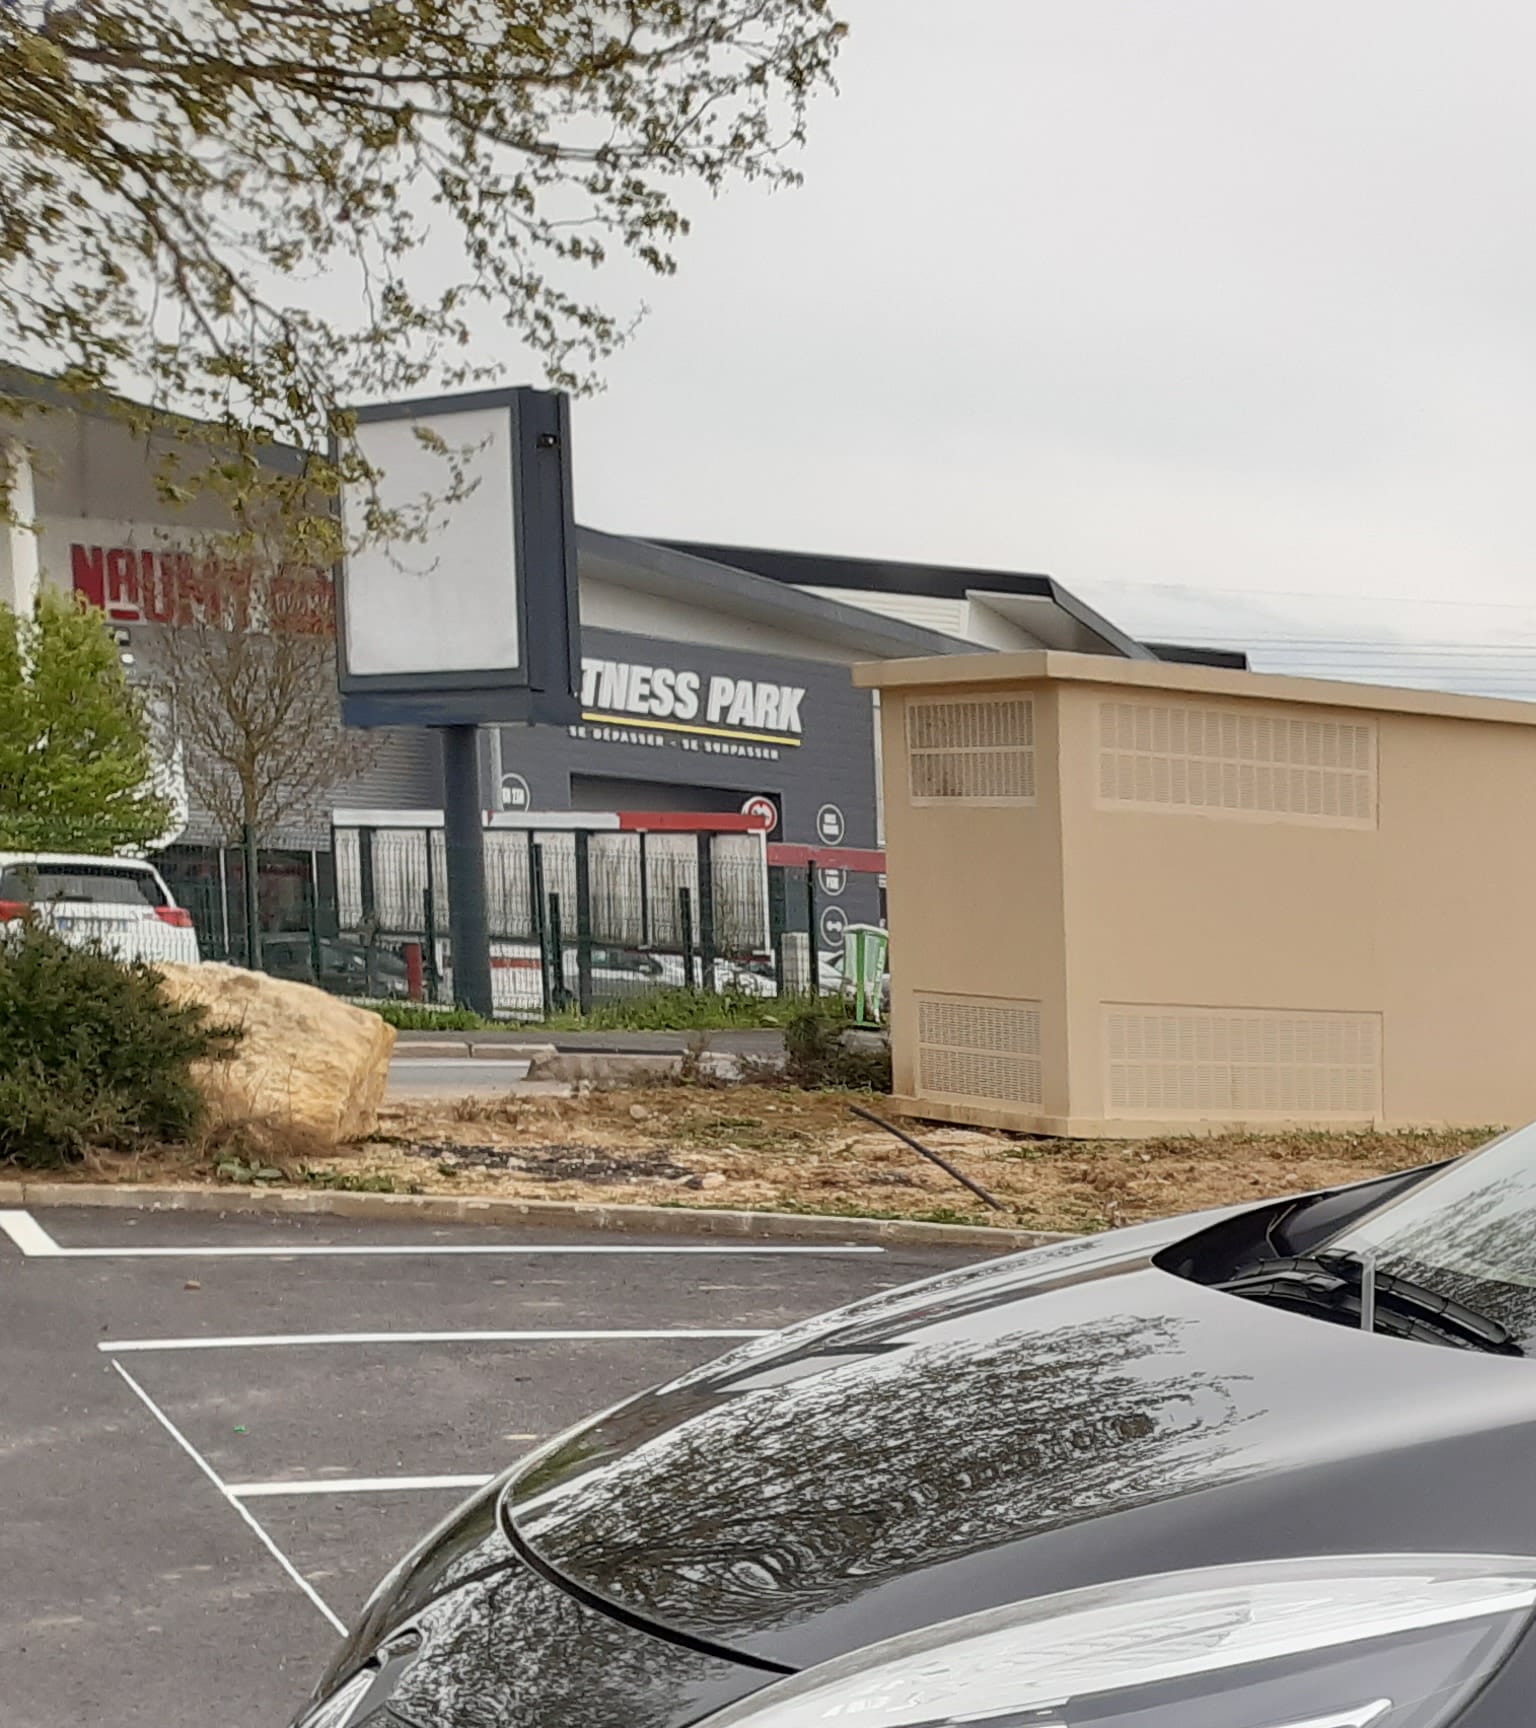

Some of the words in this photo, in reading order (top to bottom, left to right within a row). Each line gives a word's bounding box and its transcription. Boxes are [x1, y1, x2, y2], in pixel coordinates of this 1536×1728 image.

[581, 657, 700, 720] TNESS
[706, 676, 805, 733] PARK
[569, 725, 587, 739] SE
[682, 738, 699, 752] SE
